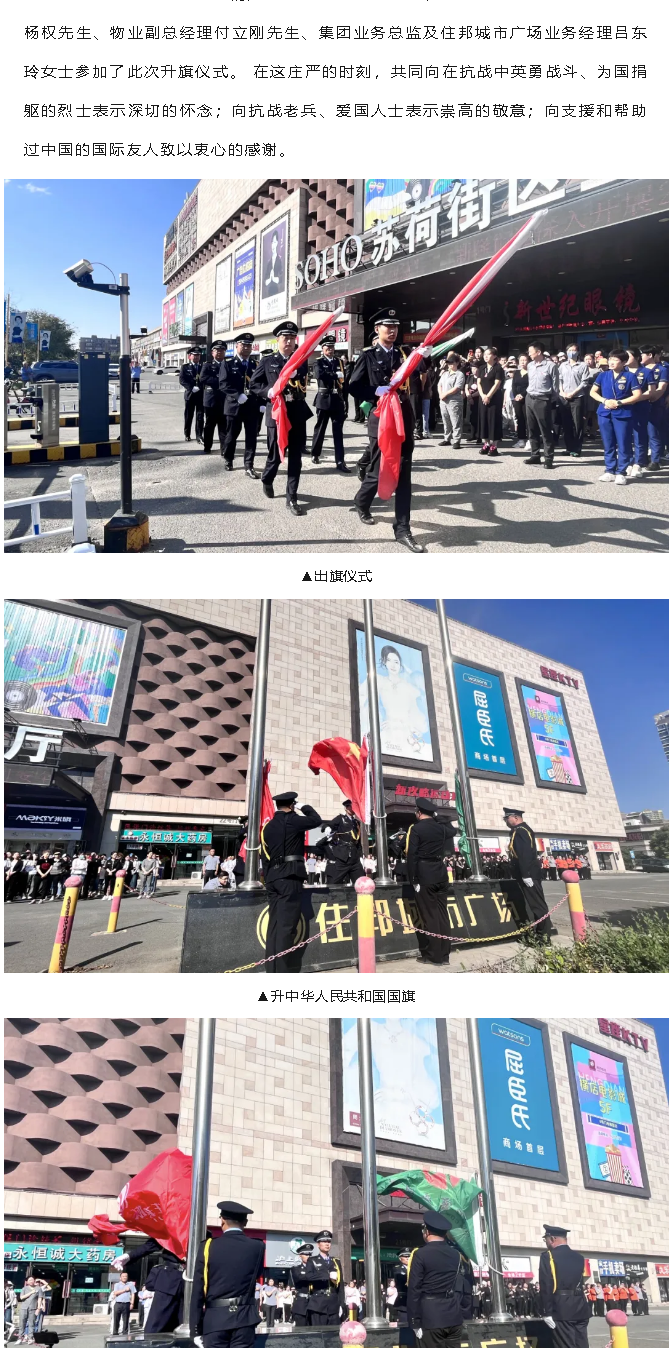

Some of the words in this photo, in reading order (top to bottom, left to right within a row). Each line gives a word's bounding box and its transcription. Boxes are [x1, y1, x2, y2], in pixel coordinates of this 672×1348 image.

[295, 234, 363, 290] SOHO
[514, 283, 641, 323] 新世纪眼镜
[473, 689, 495, 747] 屈臣氏
[4, 726, 63, 763] 厅
[504, 1048, 531, 1131] 屈臣氏
[13, 1246, 117, 1262] 永恒诚大药房
